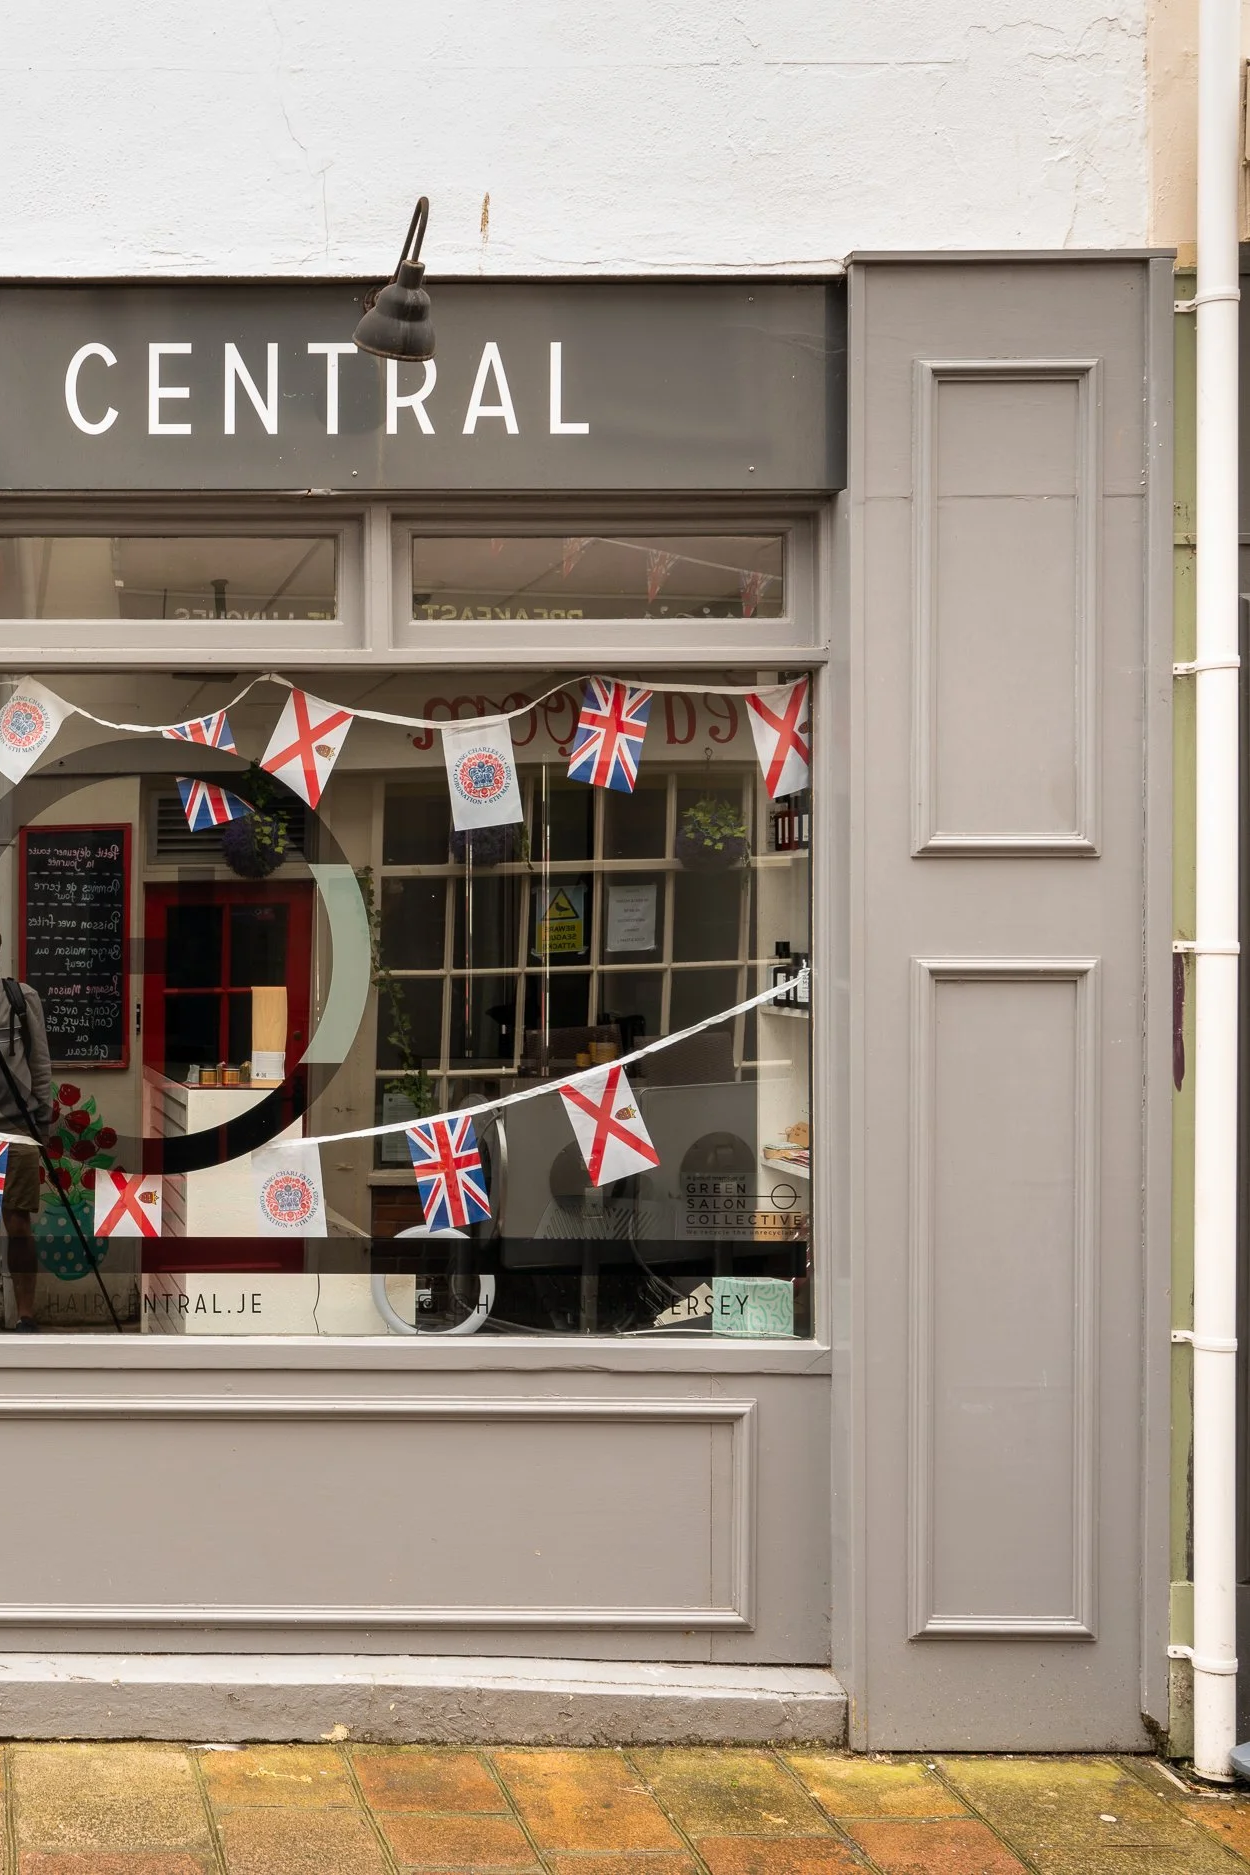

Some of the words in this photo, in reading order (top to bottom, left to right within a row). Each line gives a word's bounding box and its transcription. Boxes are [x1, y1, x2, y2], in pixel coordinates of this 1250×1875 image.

[64, 340, 591, 436] CENTRAL
[686, 1183, 746, 1194] GREEN
[686, 1198, 746, 1209] SALON
[686, 1214, 802, 1225] COLLECTIVE
[48, 1293, 262, 1314] HAIRCENTRAL.JE
